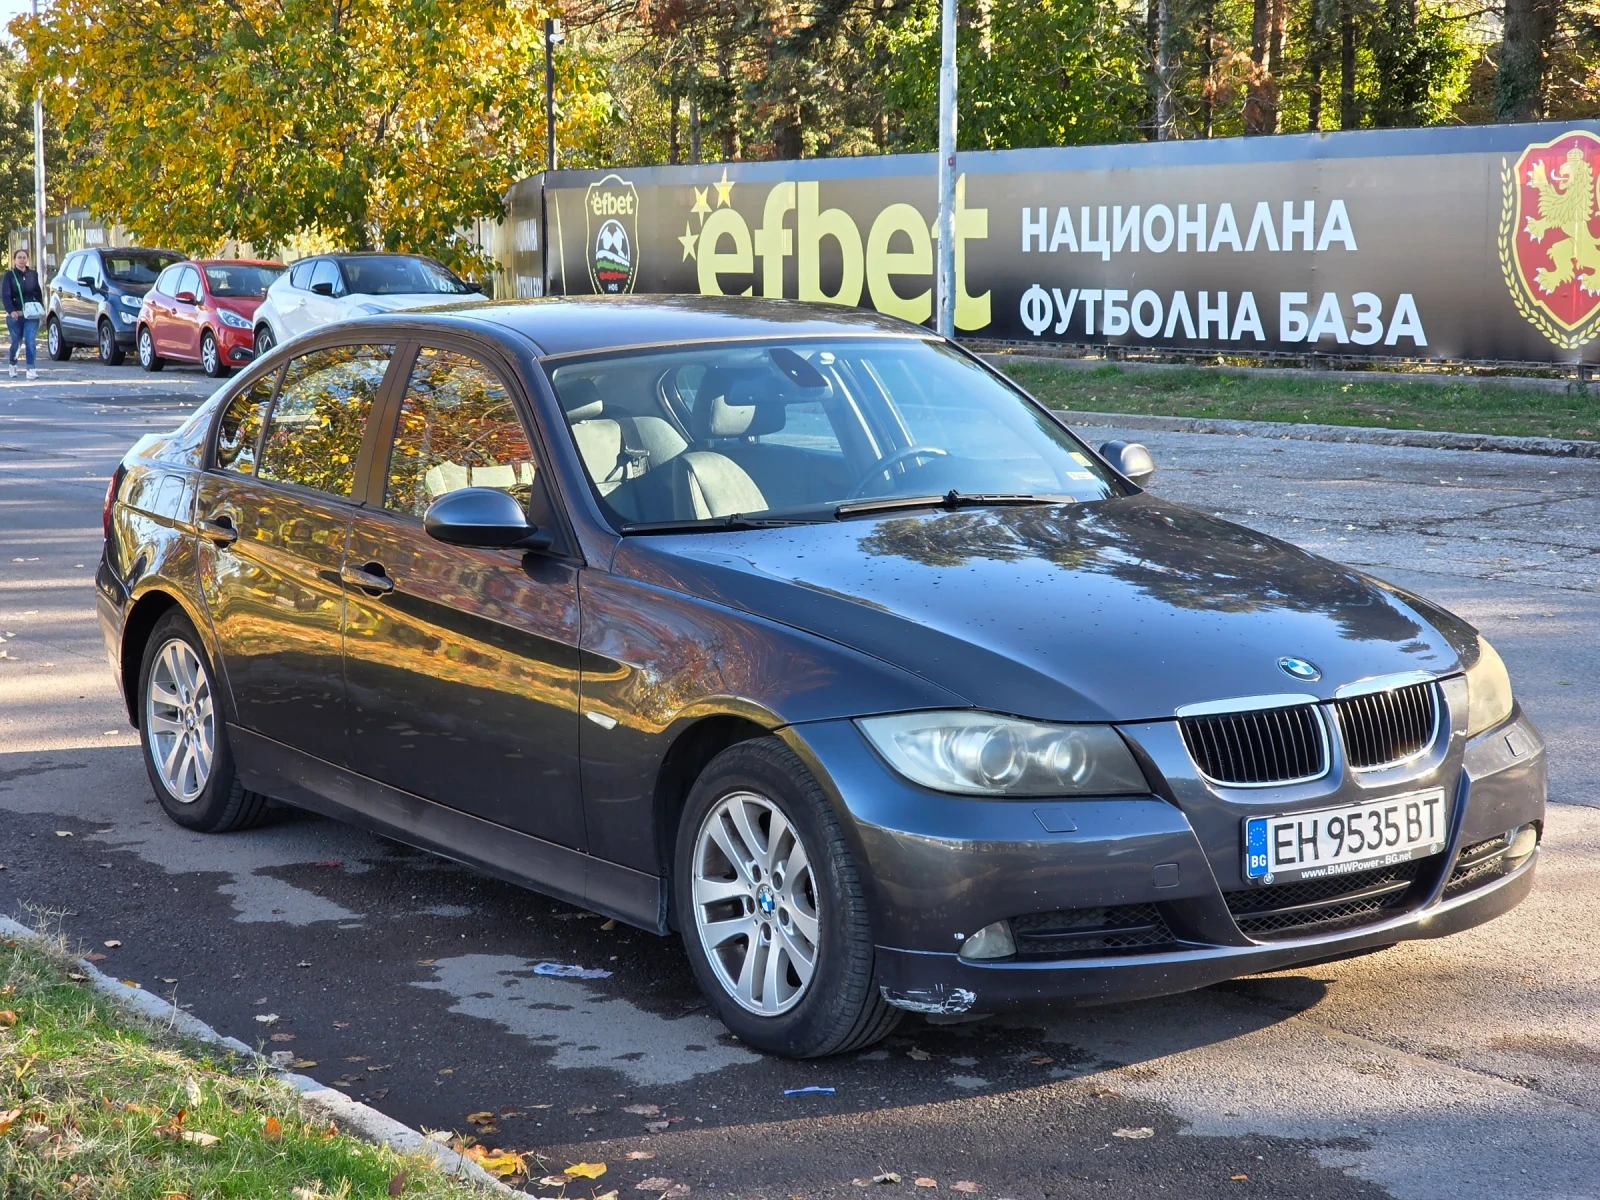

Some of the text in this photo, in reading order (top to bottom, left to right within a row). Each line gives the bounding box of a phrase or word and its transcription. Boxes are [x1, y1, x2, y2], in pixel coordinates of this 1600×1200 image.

[592, 191, 634, 216] efbet
[1022, 199, 1358, 261] НАЦИОНАЛНА
[697, 172, 992, 331] efbet
[1020, 284, 1428, 347] ФУТБОЛНА БАЗА
[1251, 854, 1267, 869] BG
[1273, 819, 1320, 866] EH
